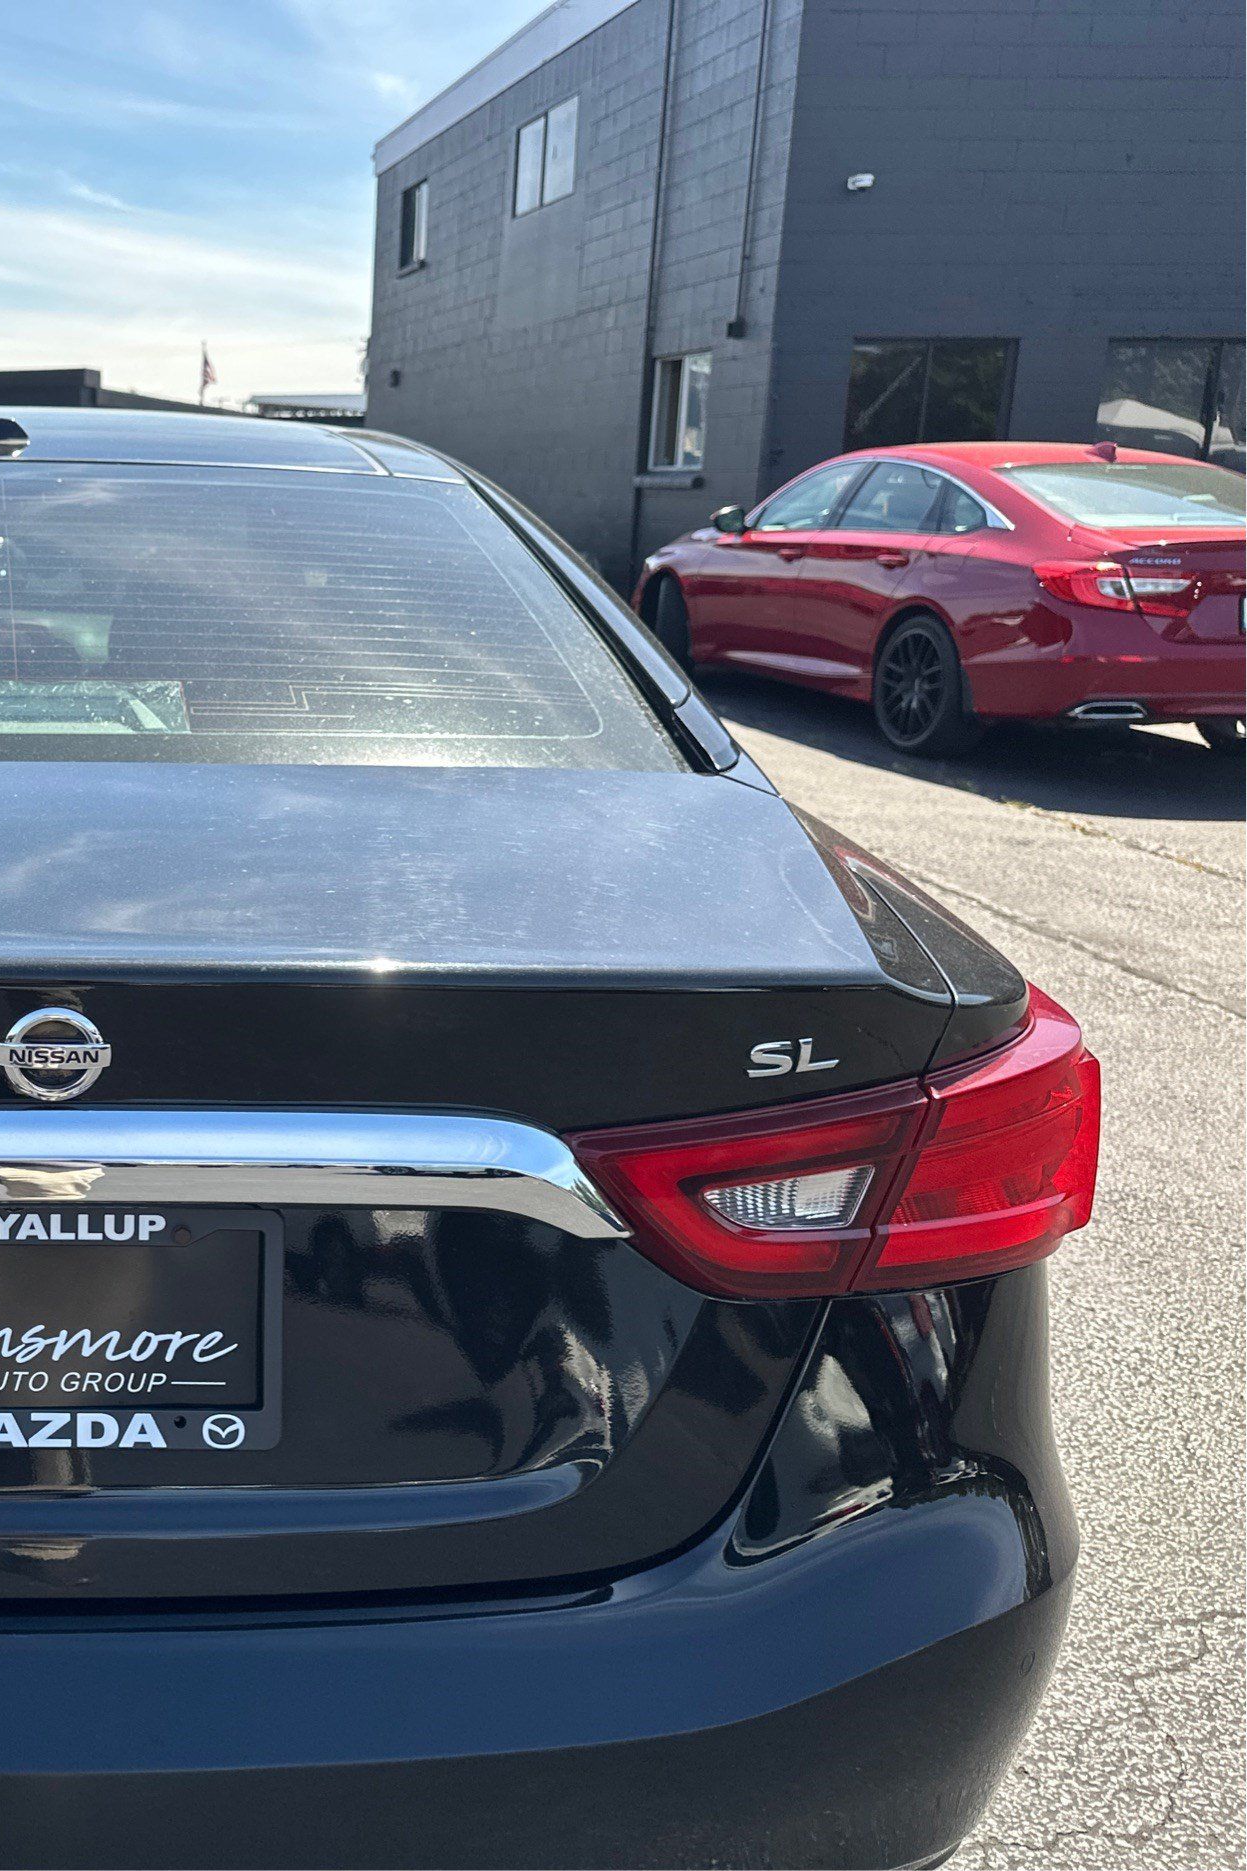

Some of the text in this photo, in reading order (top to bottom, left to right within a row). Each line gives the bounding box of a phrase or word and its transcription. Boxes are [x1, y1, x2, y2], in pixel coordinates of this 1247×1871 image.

[9, 1049, 99, 1063] NISSAN
[747, 1038, 840, 1078] SL
[61, 1371, 168, 1393] GROUP
